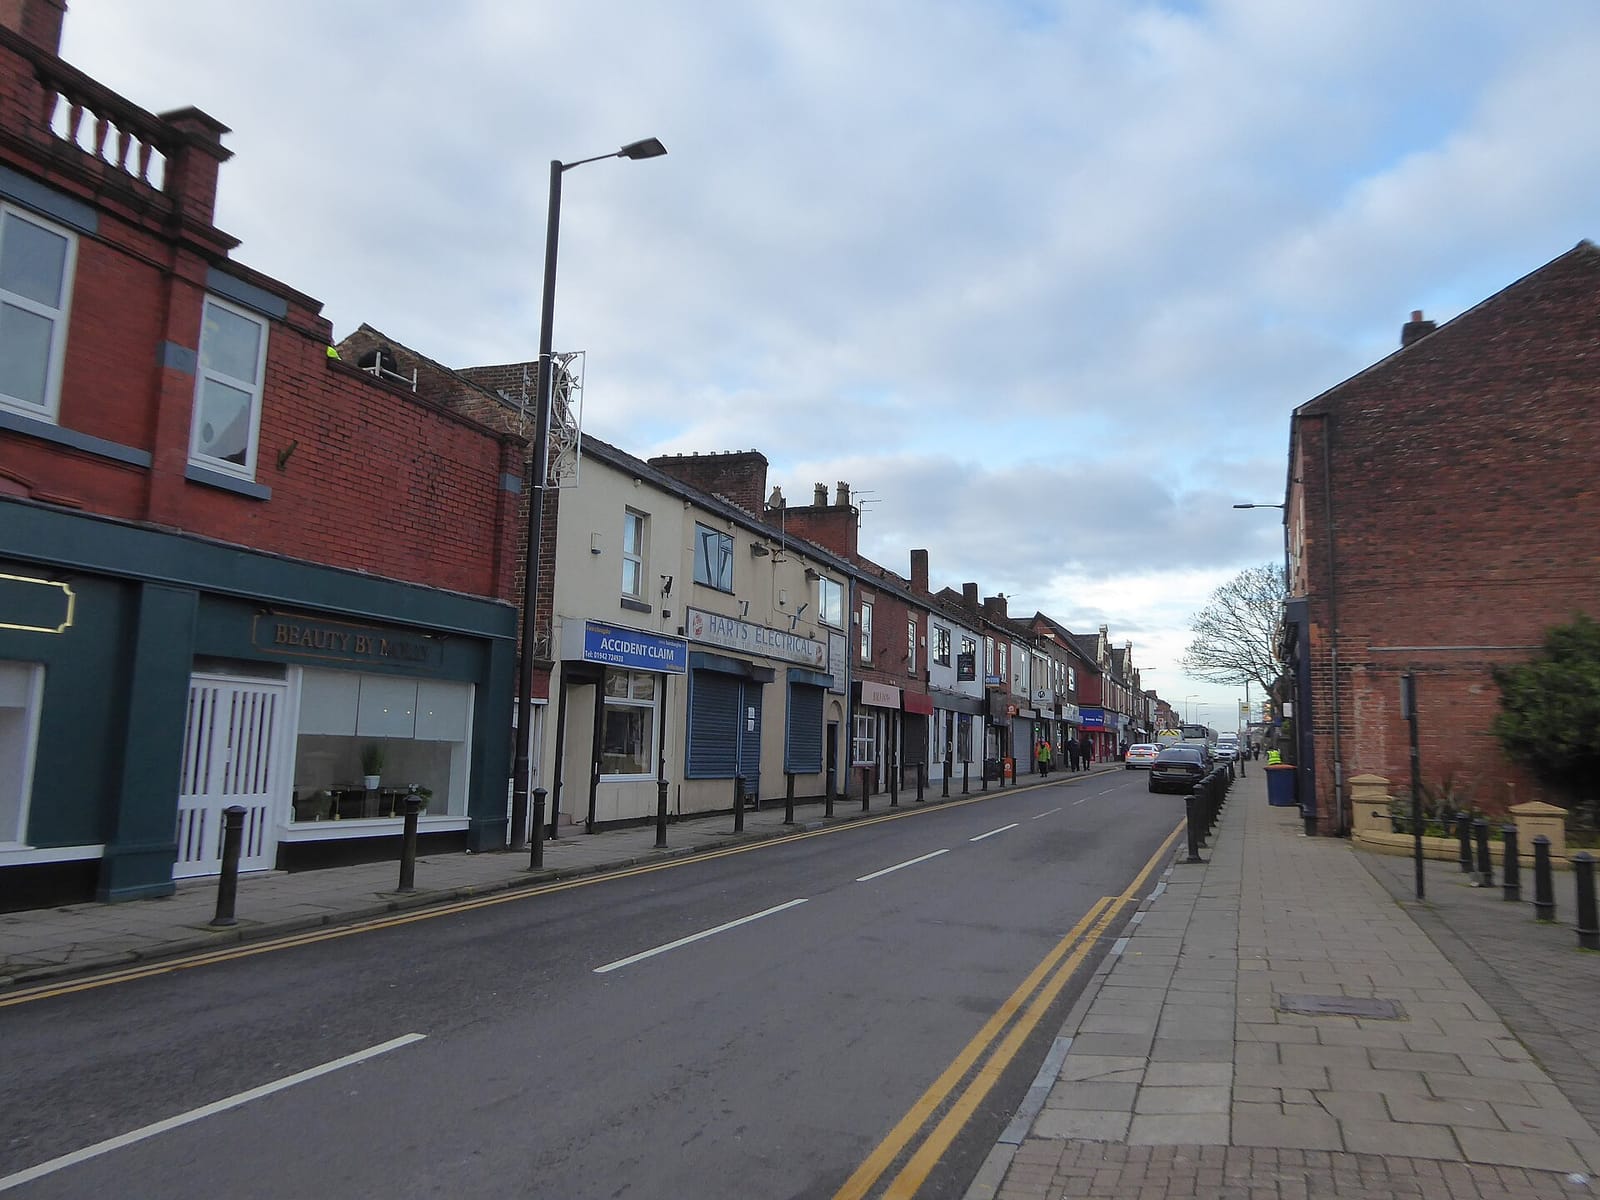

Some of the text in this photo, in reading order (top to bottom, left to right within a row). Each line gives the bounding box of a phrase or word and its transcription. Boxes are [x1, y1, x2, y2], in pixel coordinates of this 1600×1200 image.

[275, 623, 349, 650] BEAUTY
[355, 635, 374, 655] BY
[600, 637, 647, 656] ACCIDENT
[648, 646, 674, 661] CLAIM
[756, 628, 812, 655] ELECTRICAL
